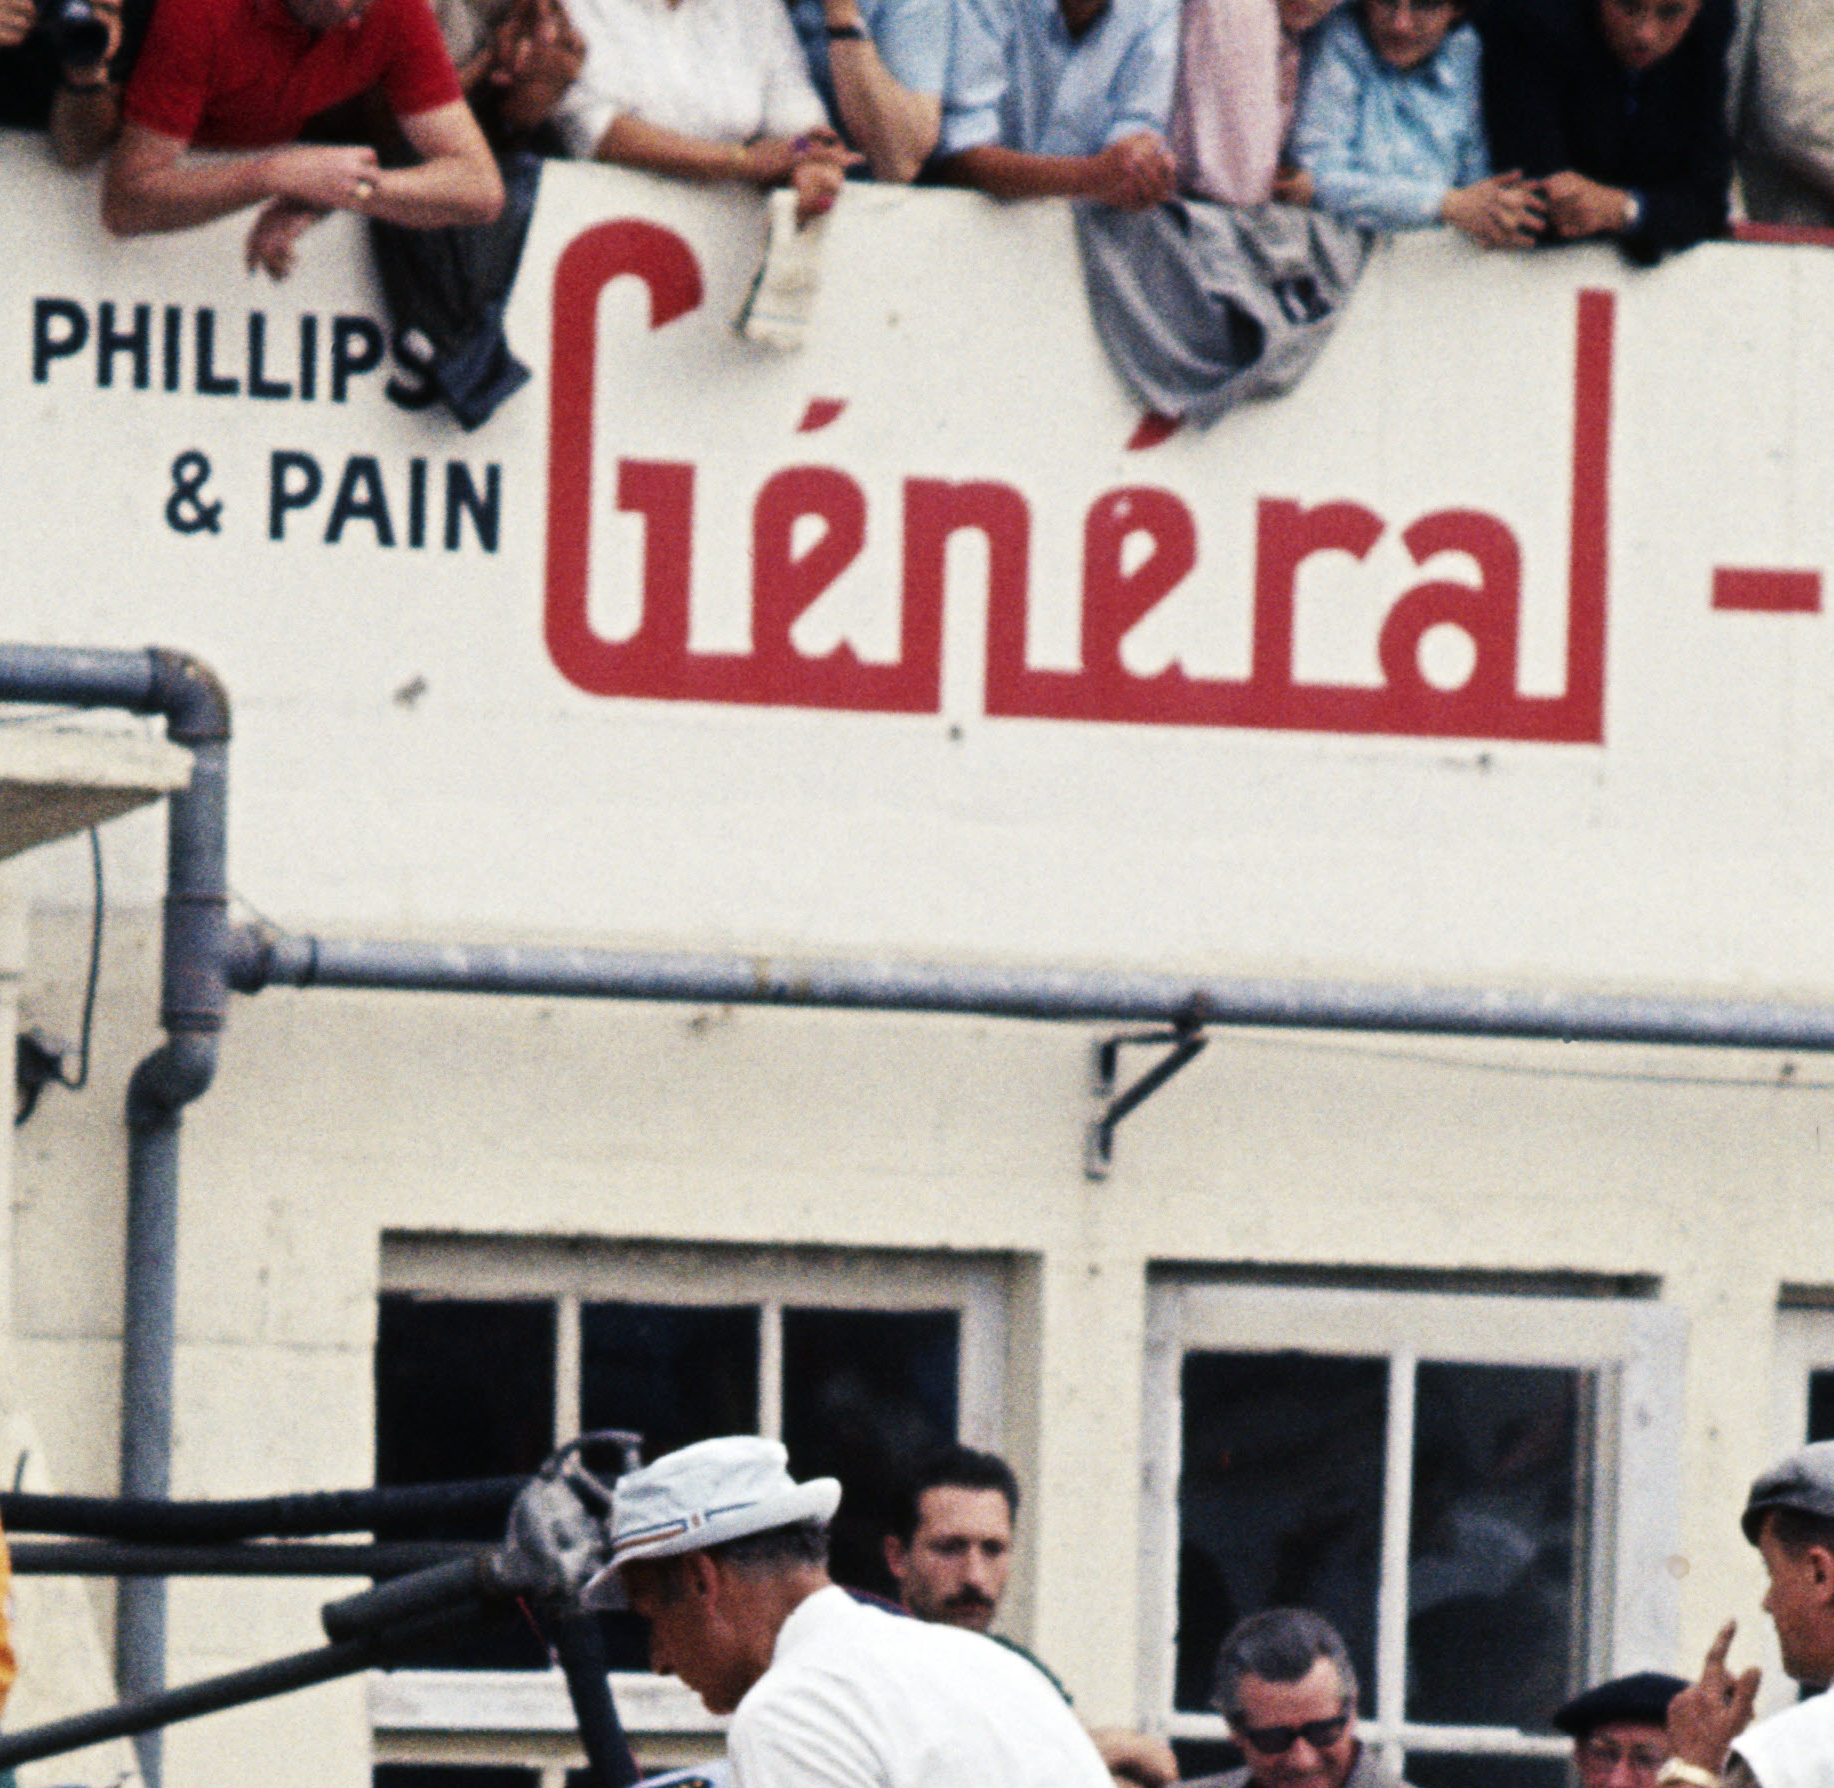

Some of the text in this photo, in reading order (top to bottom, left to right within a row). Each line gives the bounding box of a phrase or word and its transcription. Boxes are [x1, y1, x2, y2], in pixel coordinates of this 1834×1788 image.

[31, 296, 443, 412] PHILLIPS
[164, 449, 502, 554] & PAIN
[543, 218, 1615, 745] Général
